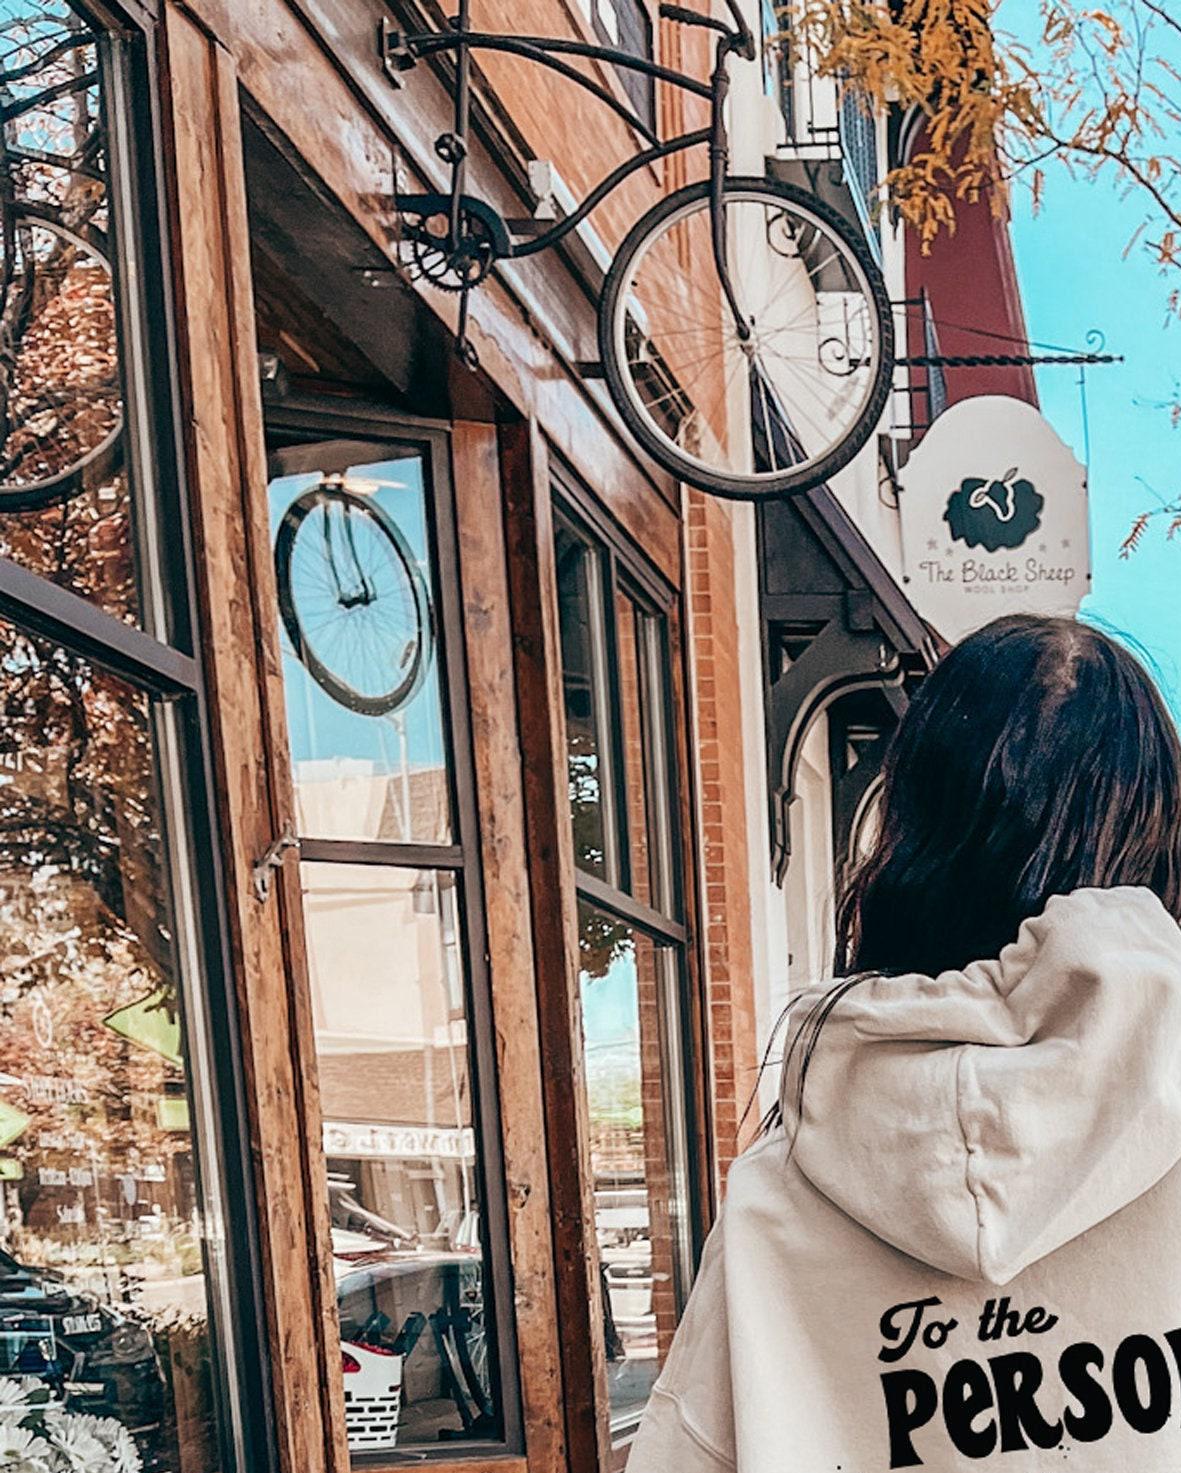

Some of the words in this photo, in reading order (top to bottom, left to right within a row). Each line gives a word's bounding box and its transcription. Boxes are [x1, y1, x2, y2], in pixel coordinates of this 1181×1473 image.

[919, 560, 955, 583] The
[961, 558, 1019, 583] Black
[1024, 557, 1076, 587] Sheep
[877, 1296, 959, 1364] To
[977, 1296, 1060, 1342] the
